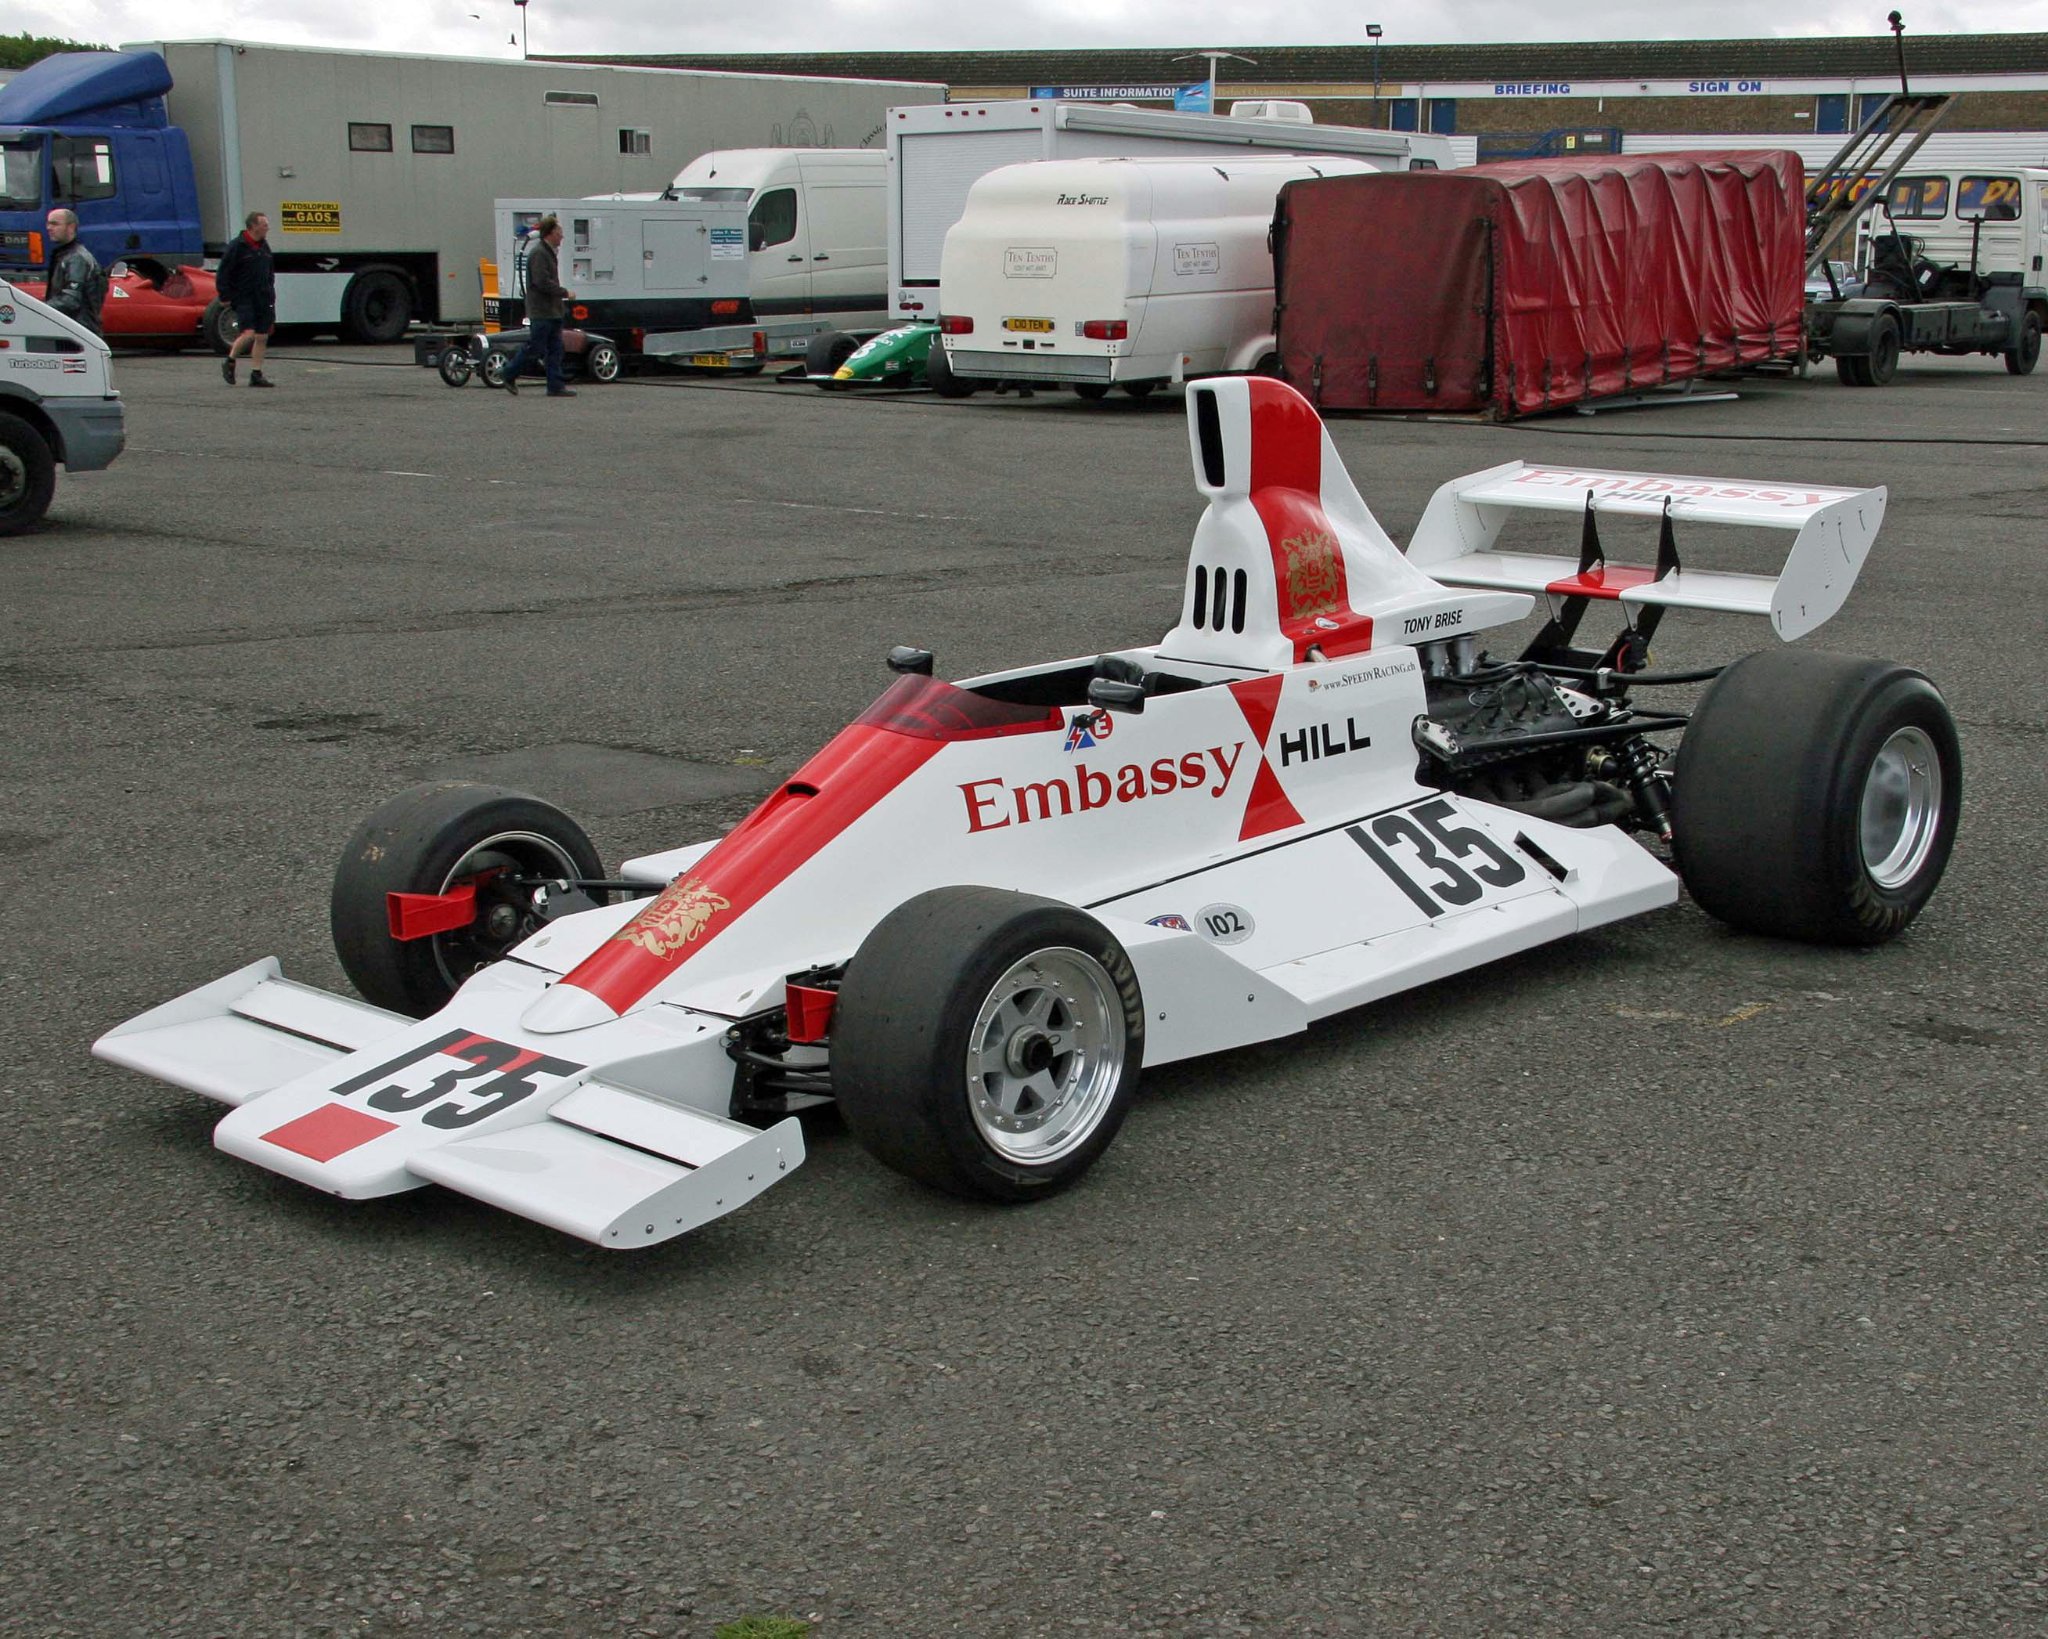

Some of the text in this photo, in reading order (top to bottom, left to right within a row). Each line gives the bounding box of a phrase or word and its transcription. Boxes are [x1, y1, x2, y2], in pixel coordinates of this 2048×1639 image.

[1063, 88, 1097, 98] SUITE
[1494, 83, 1571, 95] BRIEFING
[1689, 81, 1762, 92] SIGN ON
[1510, 470, 1850, 507] Embassy
[1404, 609, 1463, 635] TONY BRISE
[1280, 717, 1371, 767] HILL
[957, 741, 1246, 833] Embassy
[1344, 798, 1526, 919] 135
[1204, 911, 1246, 937] 102
[328, 1027, 589, 1130] 135
